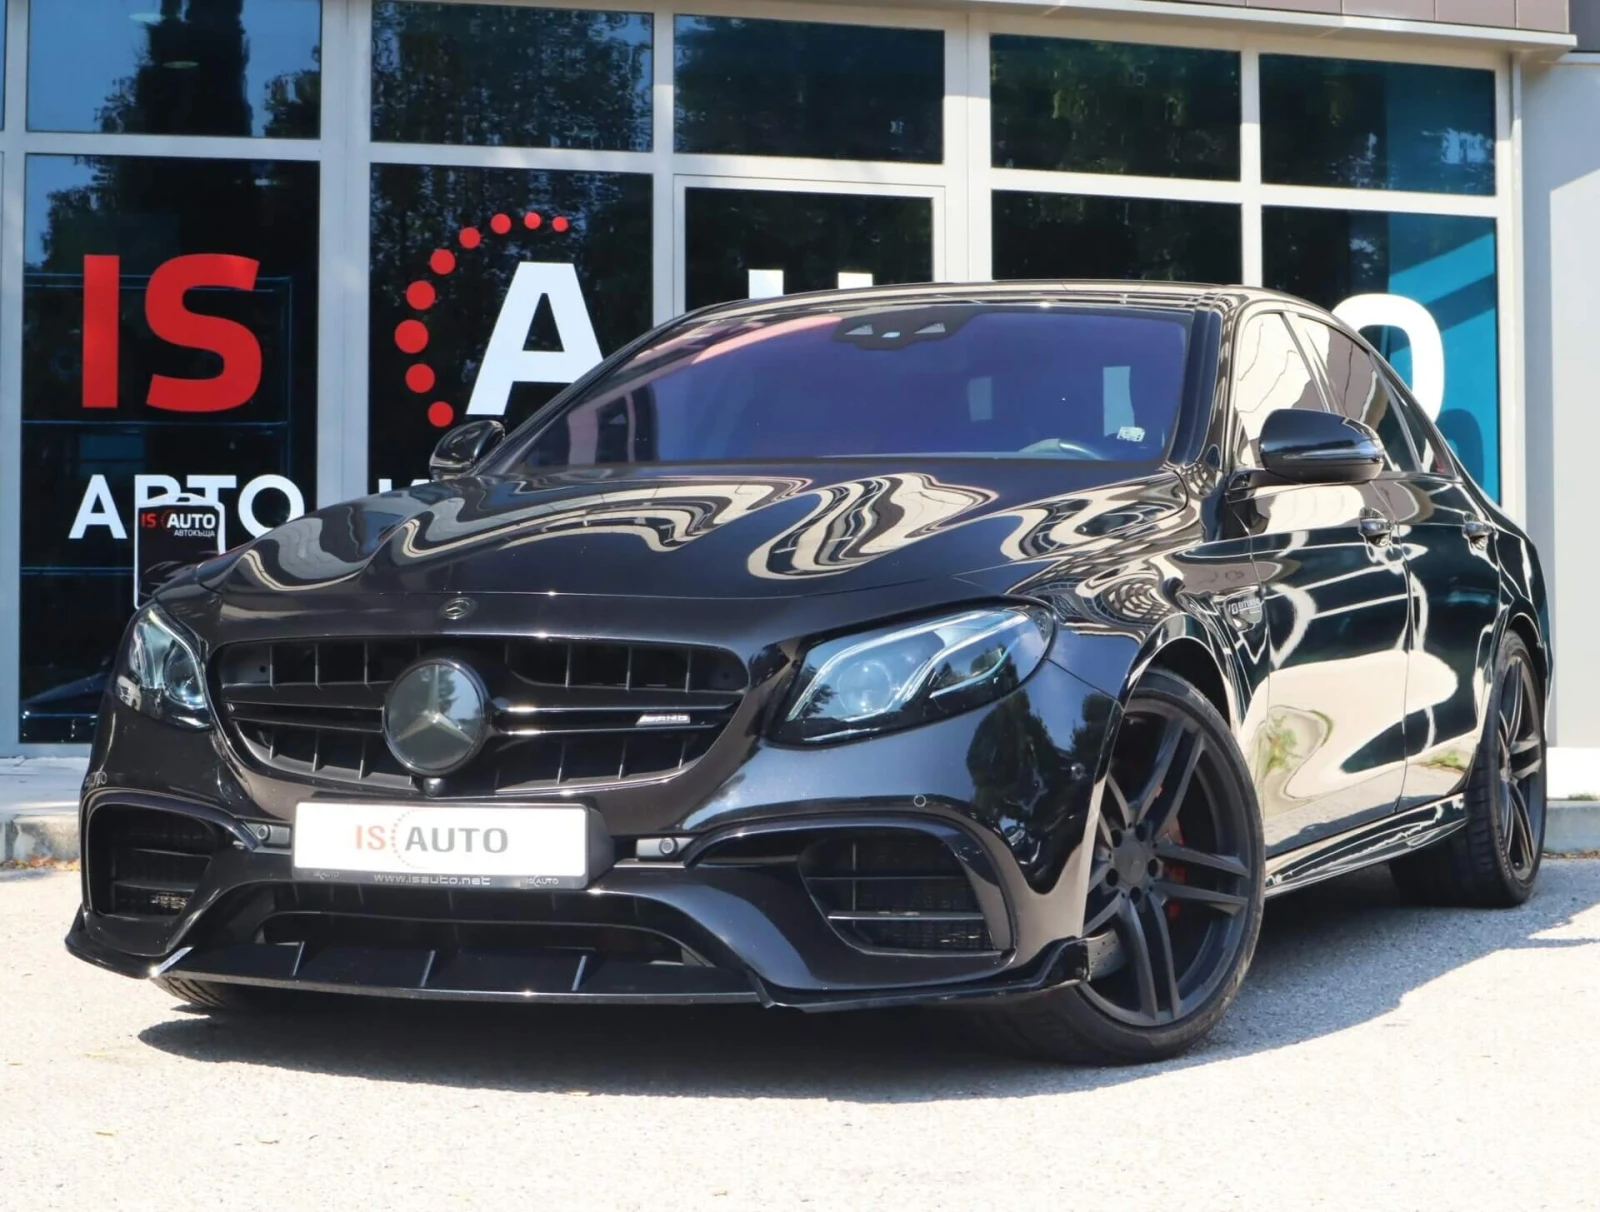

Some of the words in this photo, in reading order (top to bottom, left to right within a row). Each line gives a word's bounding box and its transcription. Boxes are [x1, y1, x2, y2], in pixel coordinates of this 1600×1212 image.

[82, 253, 262, 412] IS
[141, 513, 157, 528] IS
[166, 513, 216, 529] AUTO
[355, 825, 386, 851] IS
[405, 826, 509, 853] AUTO
[373, 873, 491, 886] www.isauto.net
